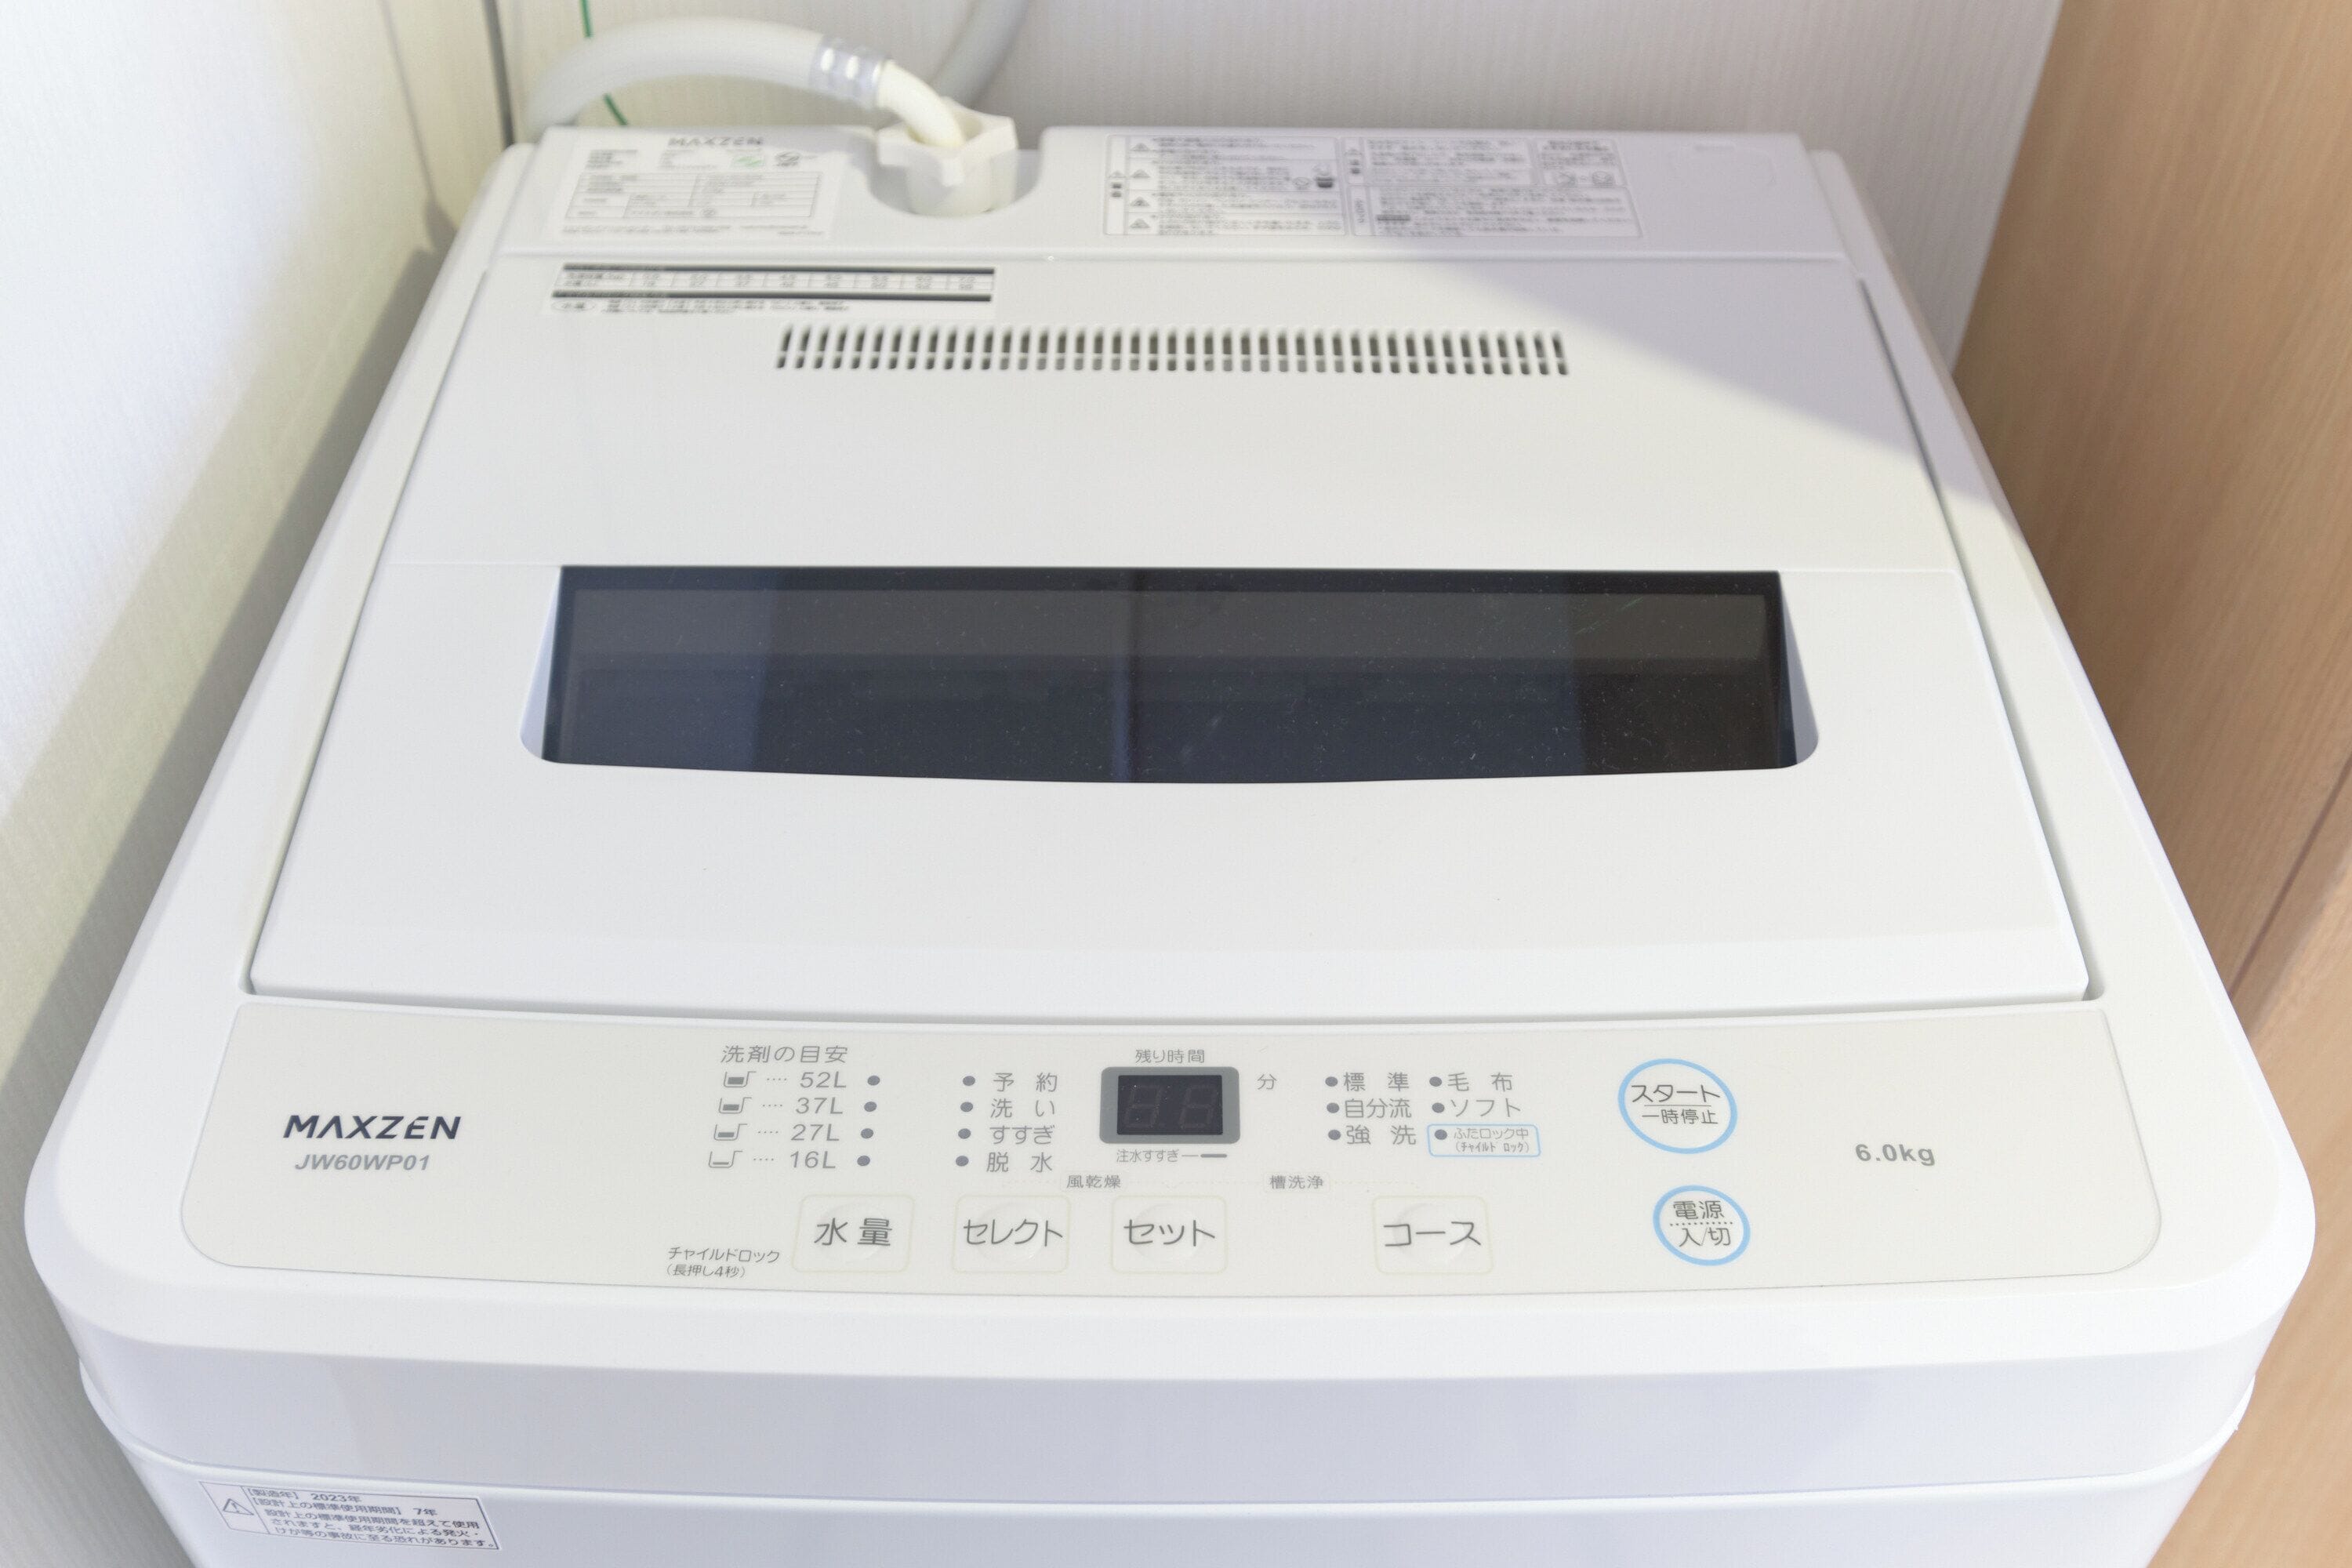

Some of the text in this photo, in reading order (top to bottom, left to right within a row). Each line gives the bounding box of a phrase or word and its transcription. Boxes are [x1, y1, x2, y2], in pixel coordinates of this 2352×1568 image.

[668, 136, 765, 146] MAXZEN
[721, 1045, 848, 1063] 洗剤の目安
[1135, 1049, 1204, 1063] 残り時間
[800, 1071, 846, 1088] 52L
[1258, 1074, 1277, 1090] 分
[1632, 1085, 1720, 1102] スタート
[796, 1097, 843, 1114] 37L
[1345, 1098, 1411, 1118] 自分流
[1450, 1098, 1520, 1117] ソフト
[1642, 1109, 1718, 1124] 一時停止
[283, 1115, 461, 1139] MAXZEN
[791, 1123, 839, 1142] 27L
[989, 1125, 1054, 1145] すすぎ
[1454, 1127, 1528, 1140] ふたロック中
[295, 1155, 429, 1171] JW60WP01
[790, 1151, 836, 1168] 16L
[1116, 1149, 1179, 1163] 注水すすぎ
[1856, 1144, 1935, 1166] 6.0kg
[1067, 1175, 1120, 1189] 風乾燥
[1270, 1175, 1323, 1189] 槽洗浄
[1673, 1201, 1724, 1219] 電源
[814, 1218, 892, 1246] 水量
[964, 1219, 1062, 1247] セレクト
[1123, 1219, 1215, 1247] セット
[1384, 1221, 1481, 1247] コース
[669, 1247, 779, 1263] チャイルドロック
[311, 1493, 362, 1503] 2023年
[413, 1508, 437, 1517] 7年
